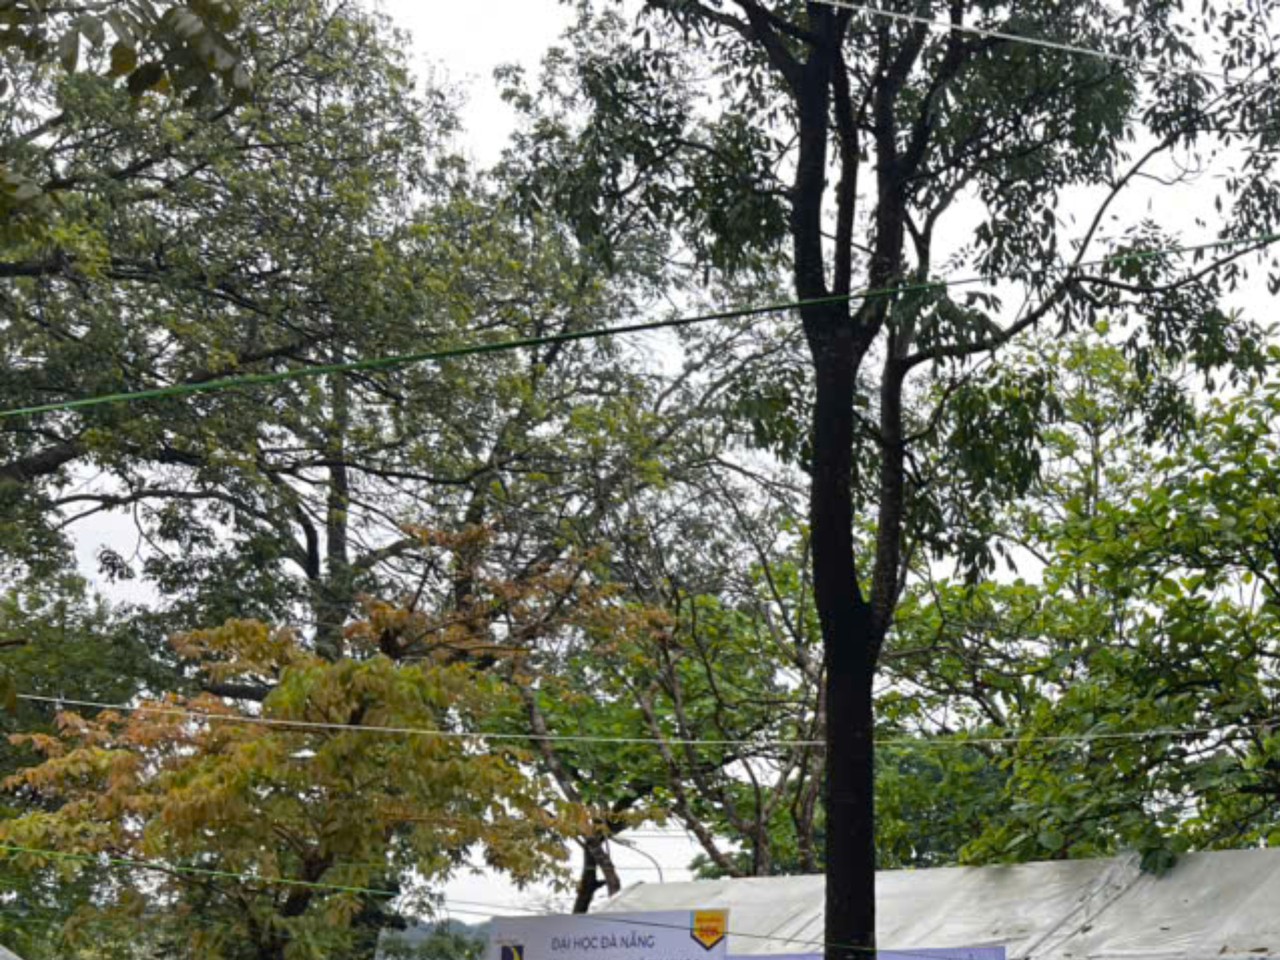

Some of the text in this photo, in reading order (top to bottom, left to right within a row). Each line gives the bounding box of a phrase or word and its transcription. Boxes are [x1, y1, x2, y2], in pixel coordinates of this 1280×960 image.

[552, 936, 570, 953] ĐẠI
[573, 935, 598, 951] HỌC
[601, 933, 618, 949] ĐÀ
